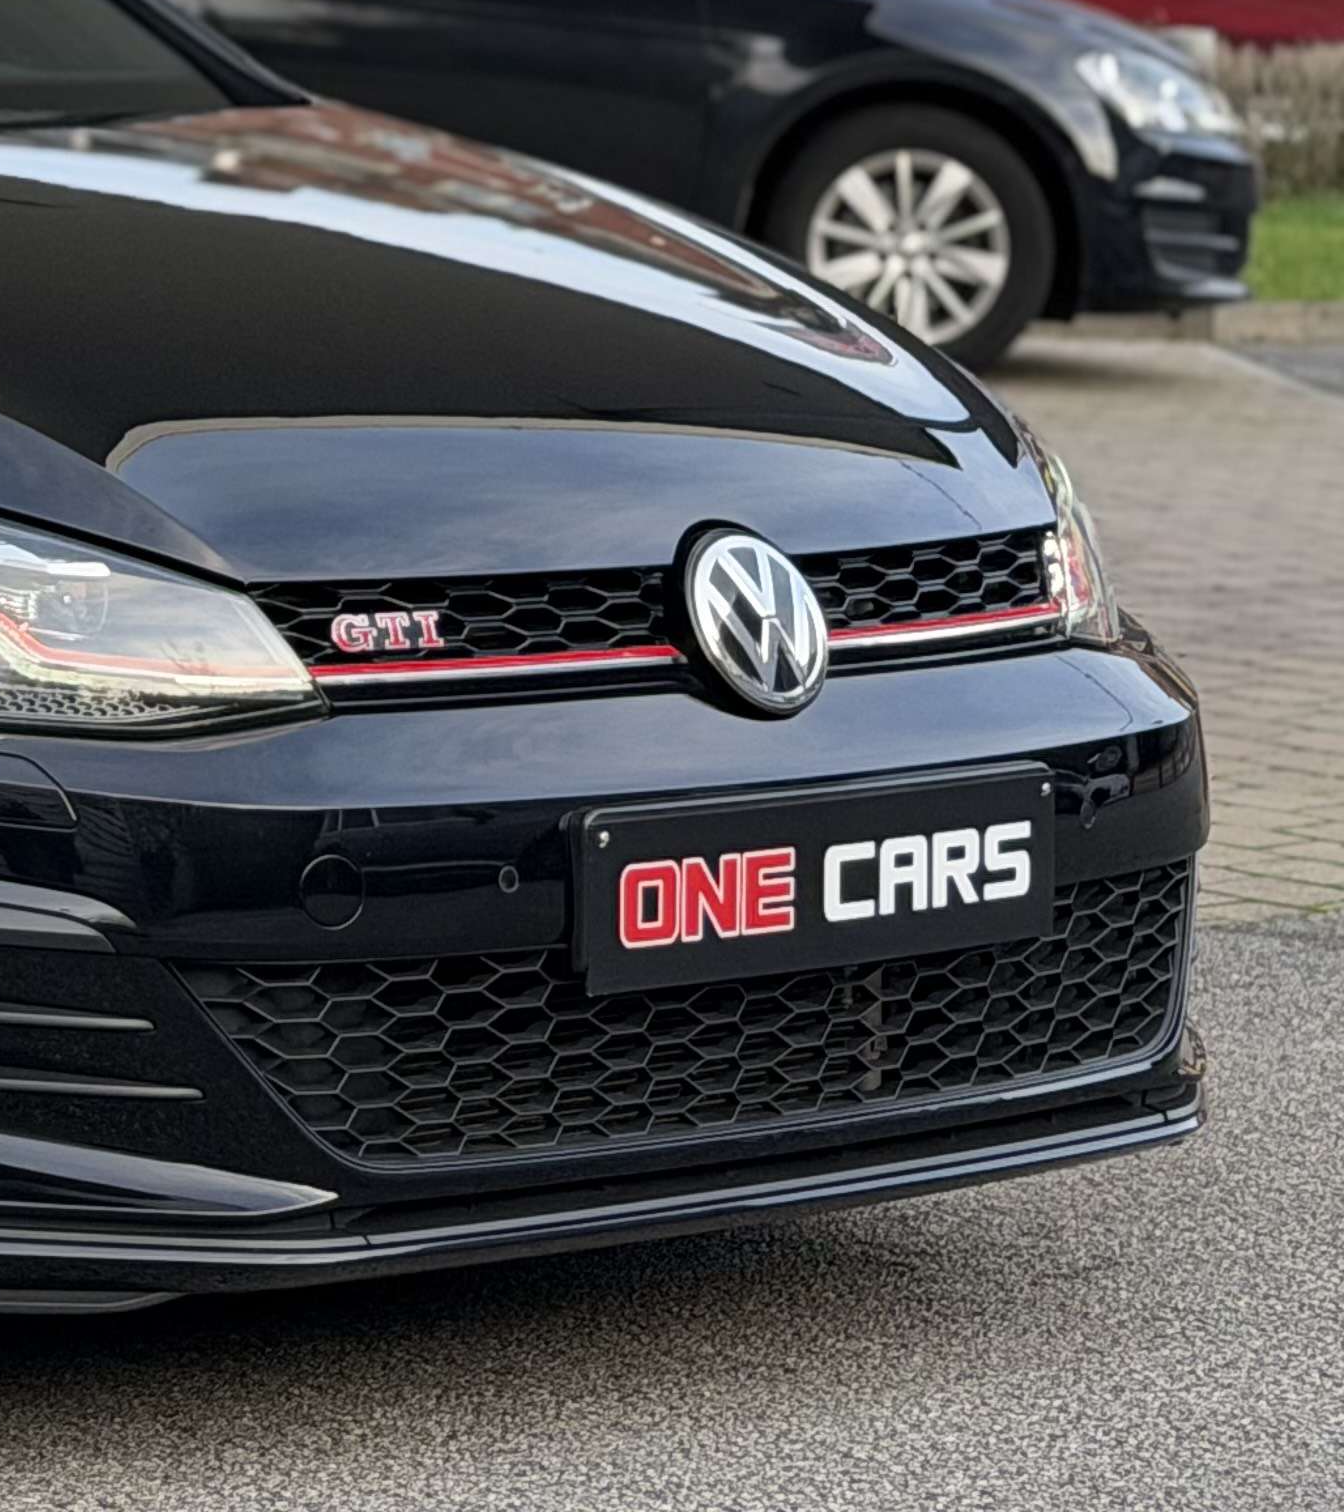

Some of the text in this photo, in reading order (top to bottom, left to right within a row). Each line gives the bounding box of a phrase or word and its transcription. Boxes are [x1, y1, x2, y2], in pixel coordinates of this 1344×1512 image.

[330, 609, 445, 653] GTI
[619, 820, 1032, 949] ONE CARS
